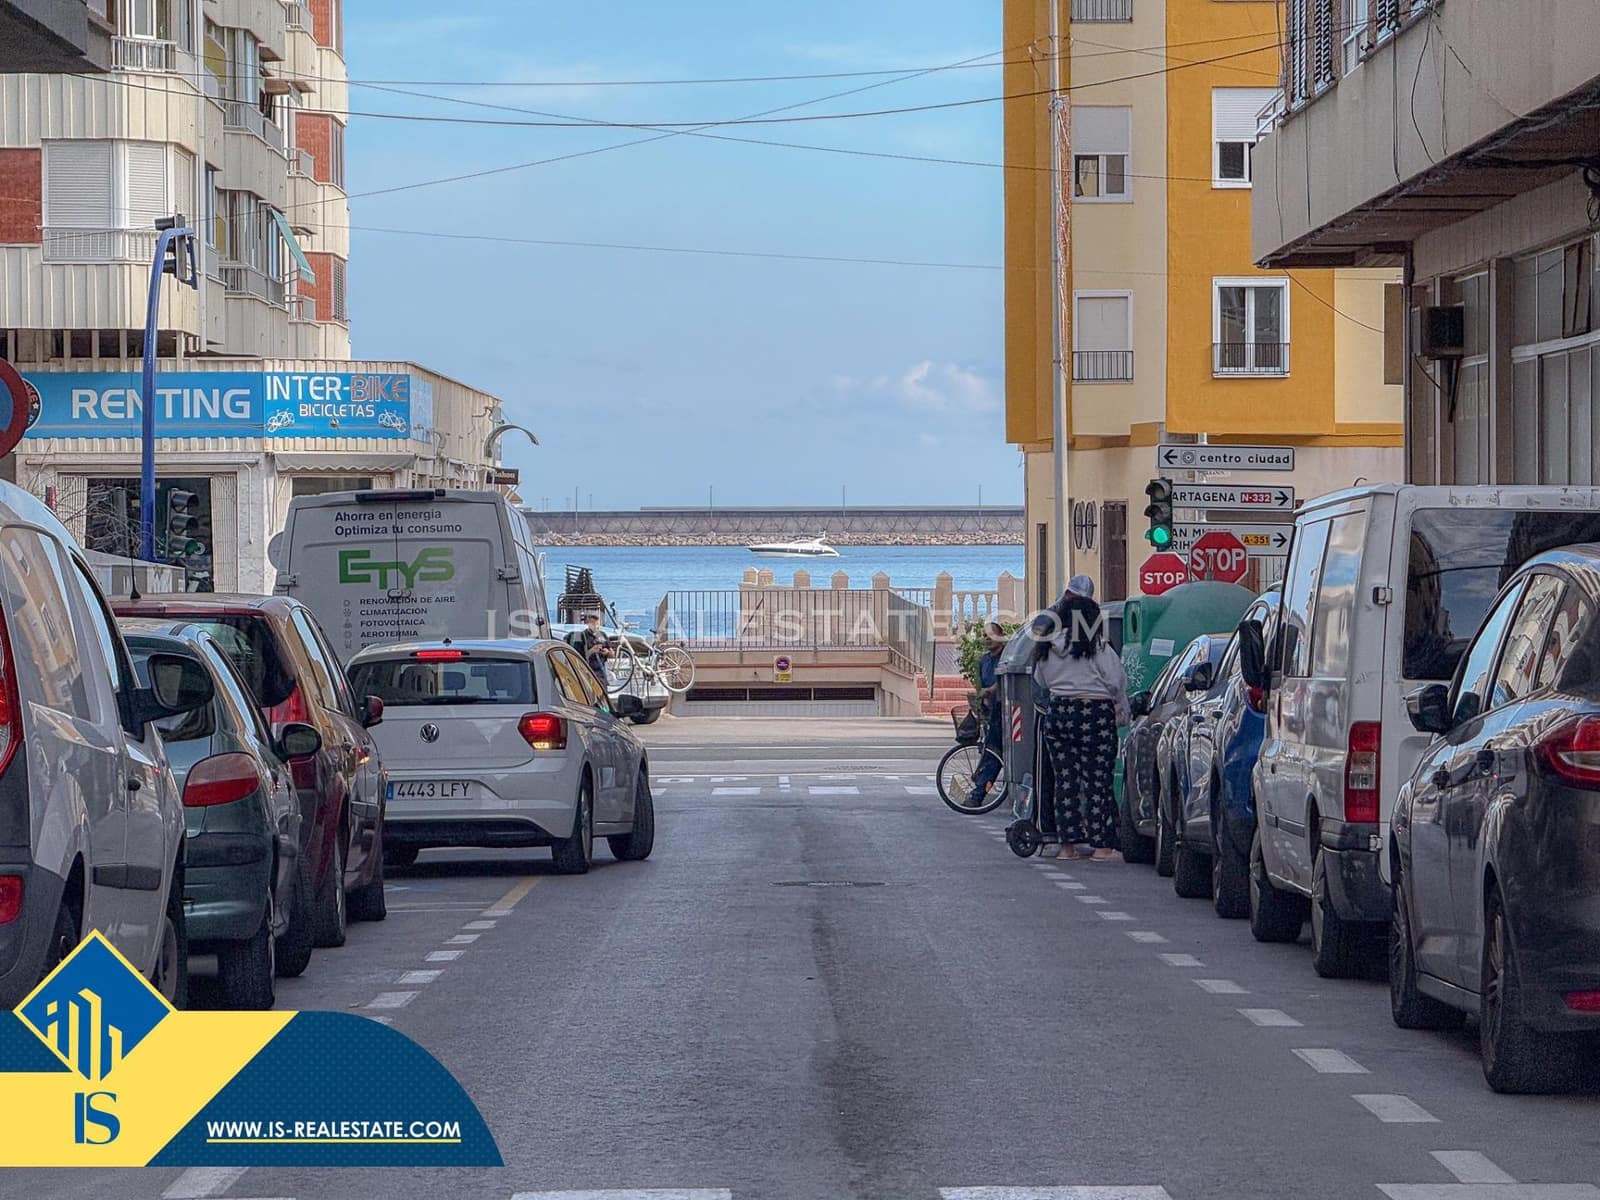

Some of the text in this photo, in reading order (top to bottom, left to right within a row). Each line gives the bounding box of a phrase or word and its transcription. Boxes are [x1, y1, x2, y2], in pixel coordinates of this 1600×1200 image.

[266, 375, 408, 401] INTER-BIKE
[71, 388, 251, 419] RENTING
[299, 403, 375, 417] BICICLETAS
[1200, 452, 1290, 464] centro ciudad
[1172, 492, 1271, 503] ARTAGENA N-332
[335, 511, 375, 522] Ahorra
[378, 512, 393, 520] en
[334, 523, 462, 537] Optimiza tu consumo
[1191, 548, 1245, 572] STOP
[1143, 571, 1185, 585] STOP
[360, 619, 426, 628] FOTOVOLTAICA
[360, 630, 419, 638] AEROTERMIA
[397, 783, 469, 797] 4443 LFY
